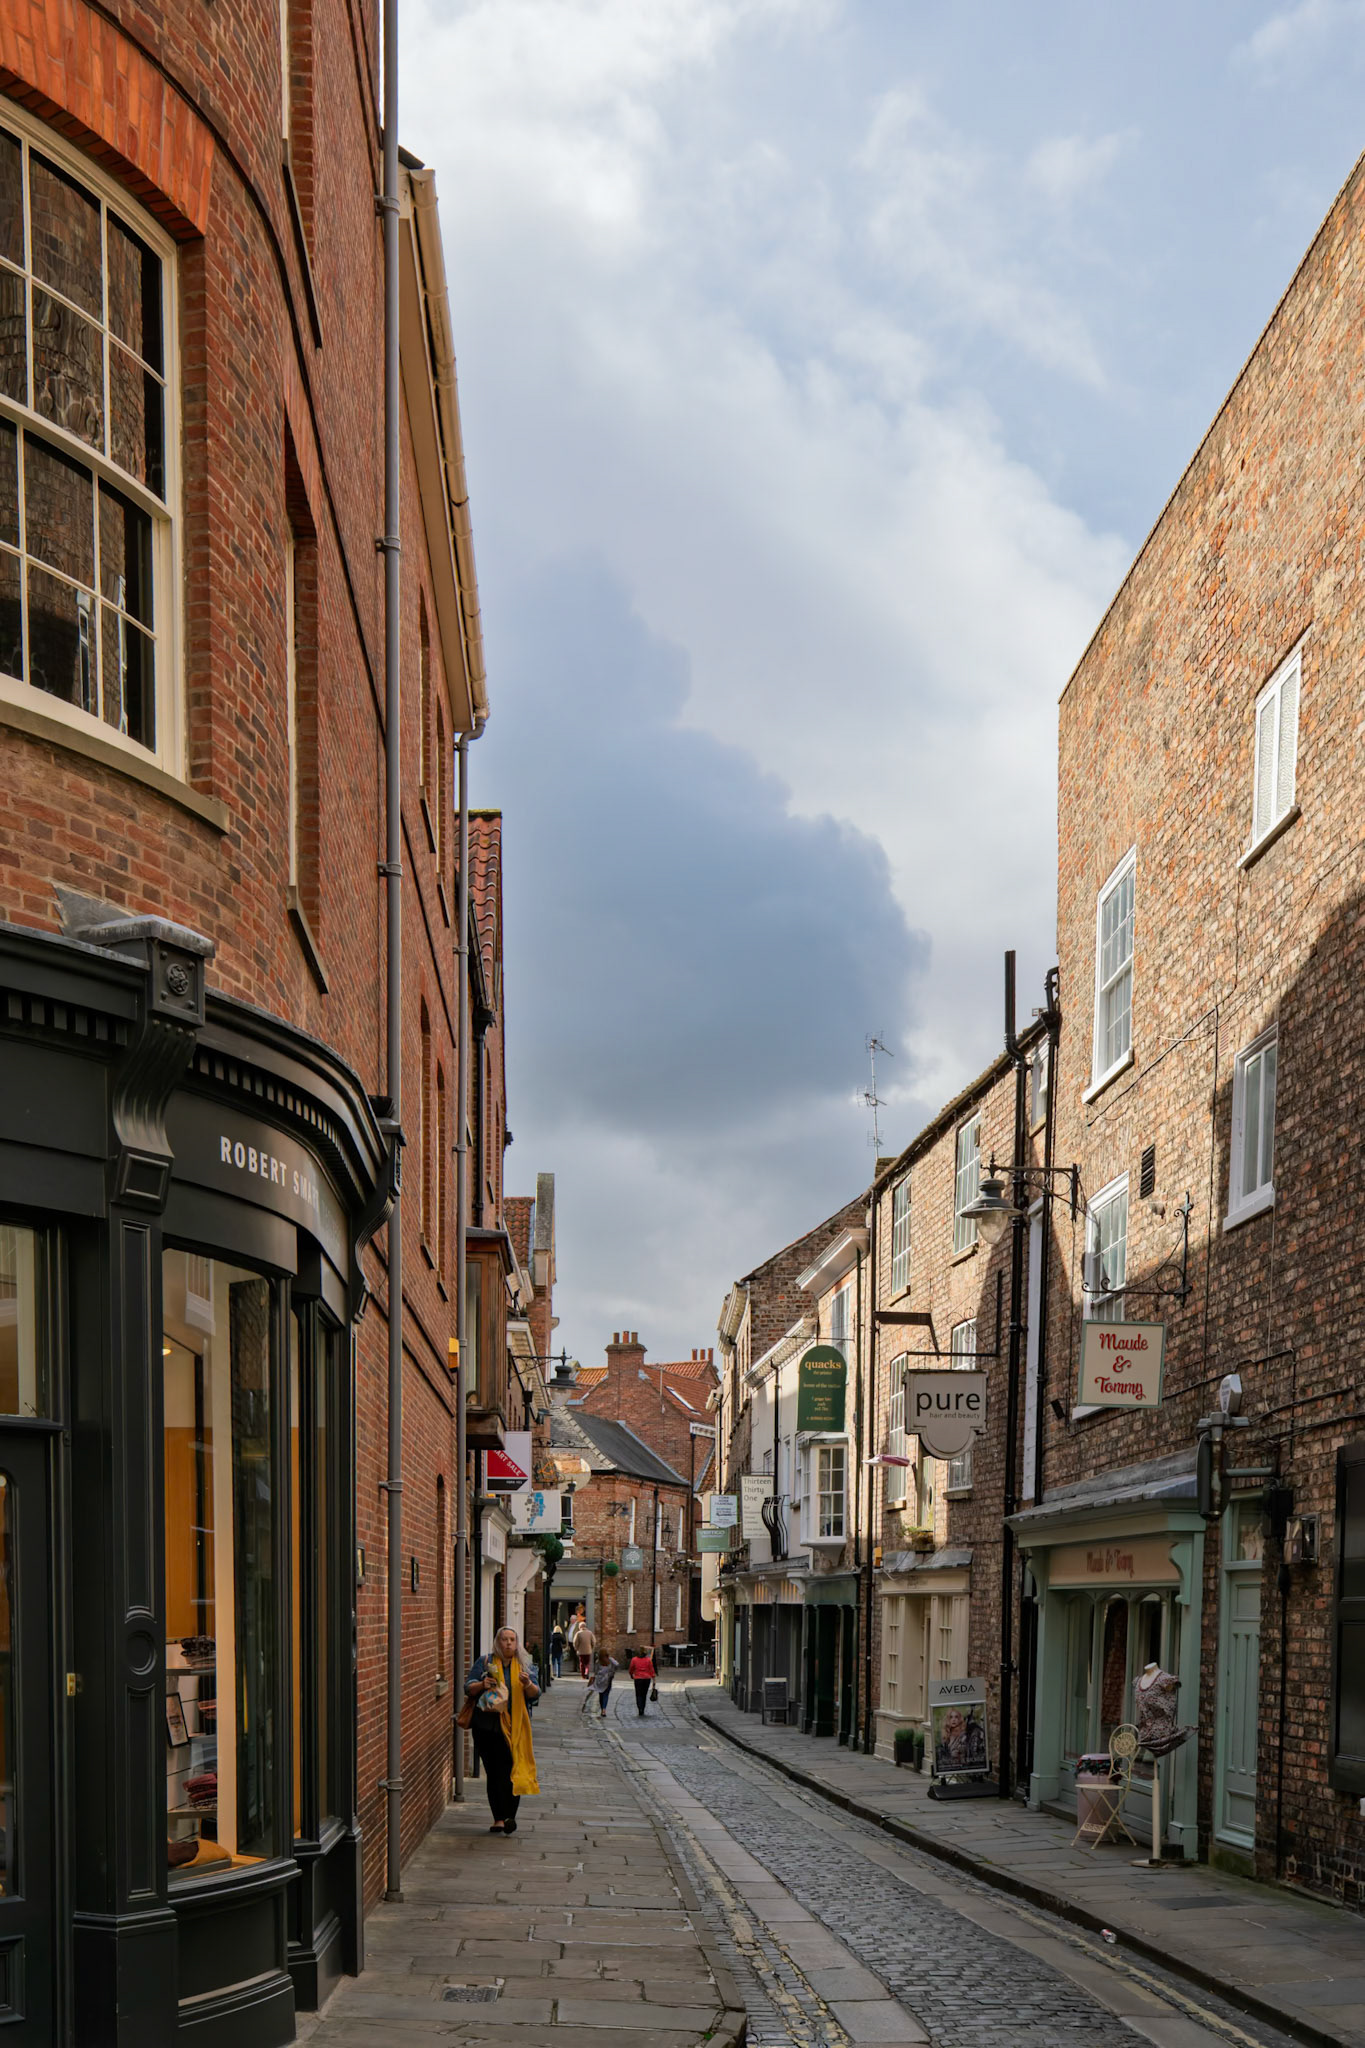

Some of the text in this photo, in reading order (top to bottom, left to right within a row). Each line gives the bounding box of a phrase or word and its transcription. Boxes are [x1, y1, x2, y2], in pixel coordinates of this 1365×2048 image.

[220, 1136, 287, 1187] ROBERT
[1099, 1333, 1149, 1350] Maude
[804, 1360, 842, 1370] quacks
[1113, 1355, 1132, 1373] &
[1094, 1376, 1147, 1400] Tommy
[917, 1393, 980, 1416] pure
[506, 1461, 522, 1477] SALE
[744, 1487, 765, 1495] Thirty
[939, 1685, 976, 1696] AVEDA
